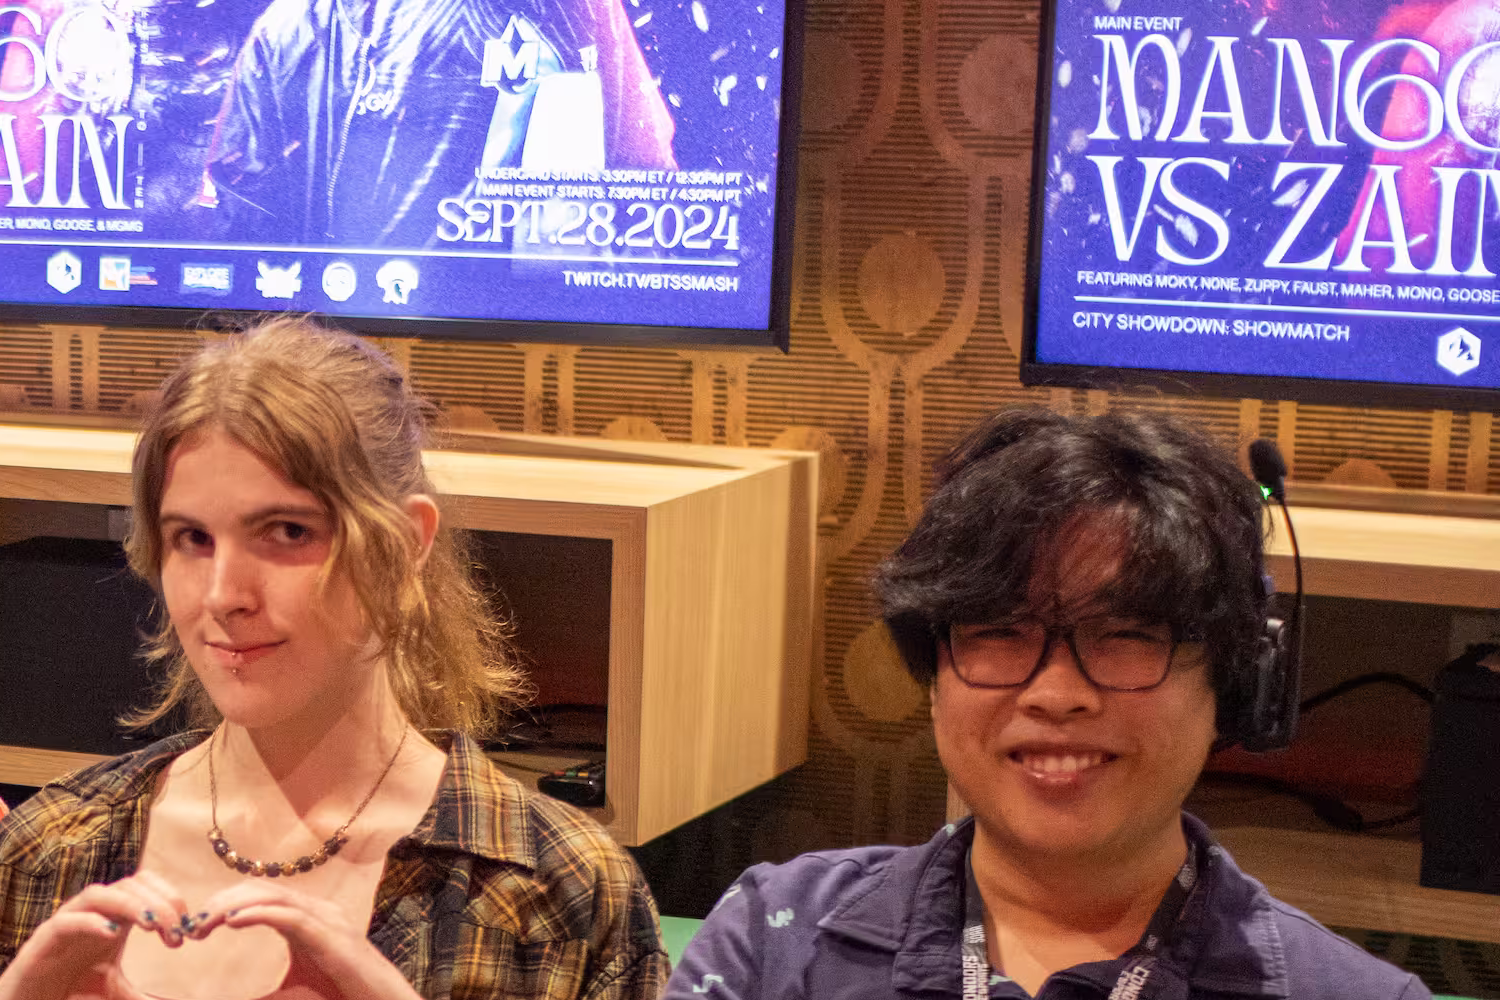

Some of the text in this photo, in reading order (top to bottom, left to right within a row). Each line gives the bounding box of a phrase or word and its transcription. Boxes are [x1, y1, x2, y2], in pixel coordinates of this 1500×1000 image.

[1094, 15, 1184, 31] MAIN EVENT
[436, 198, 739, 250] SEPT.28.2024
[1086, 155, 1500, 278] VS ZAI
[1077, 270, 1153, 287] FEATURING
[1155, 274, 1199, 290] MOKY,
[1244, 278, 1290, 295] ZUPPY,
[1293, 281, 1338, 297] FAUST,
[1341, 283, 1395, 299] MAHER,
[1398, 286, 1446, 302] MONO,
[1073, 312, 1350, 342] CITY SHOWDOWN: SHOWMATCH
